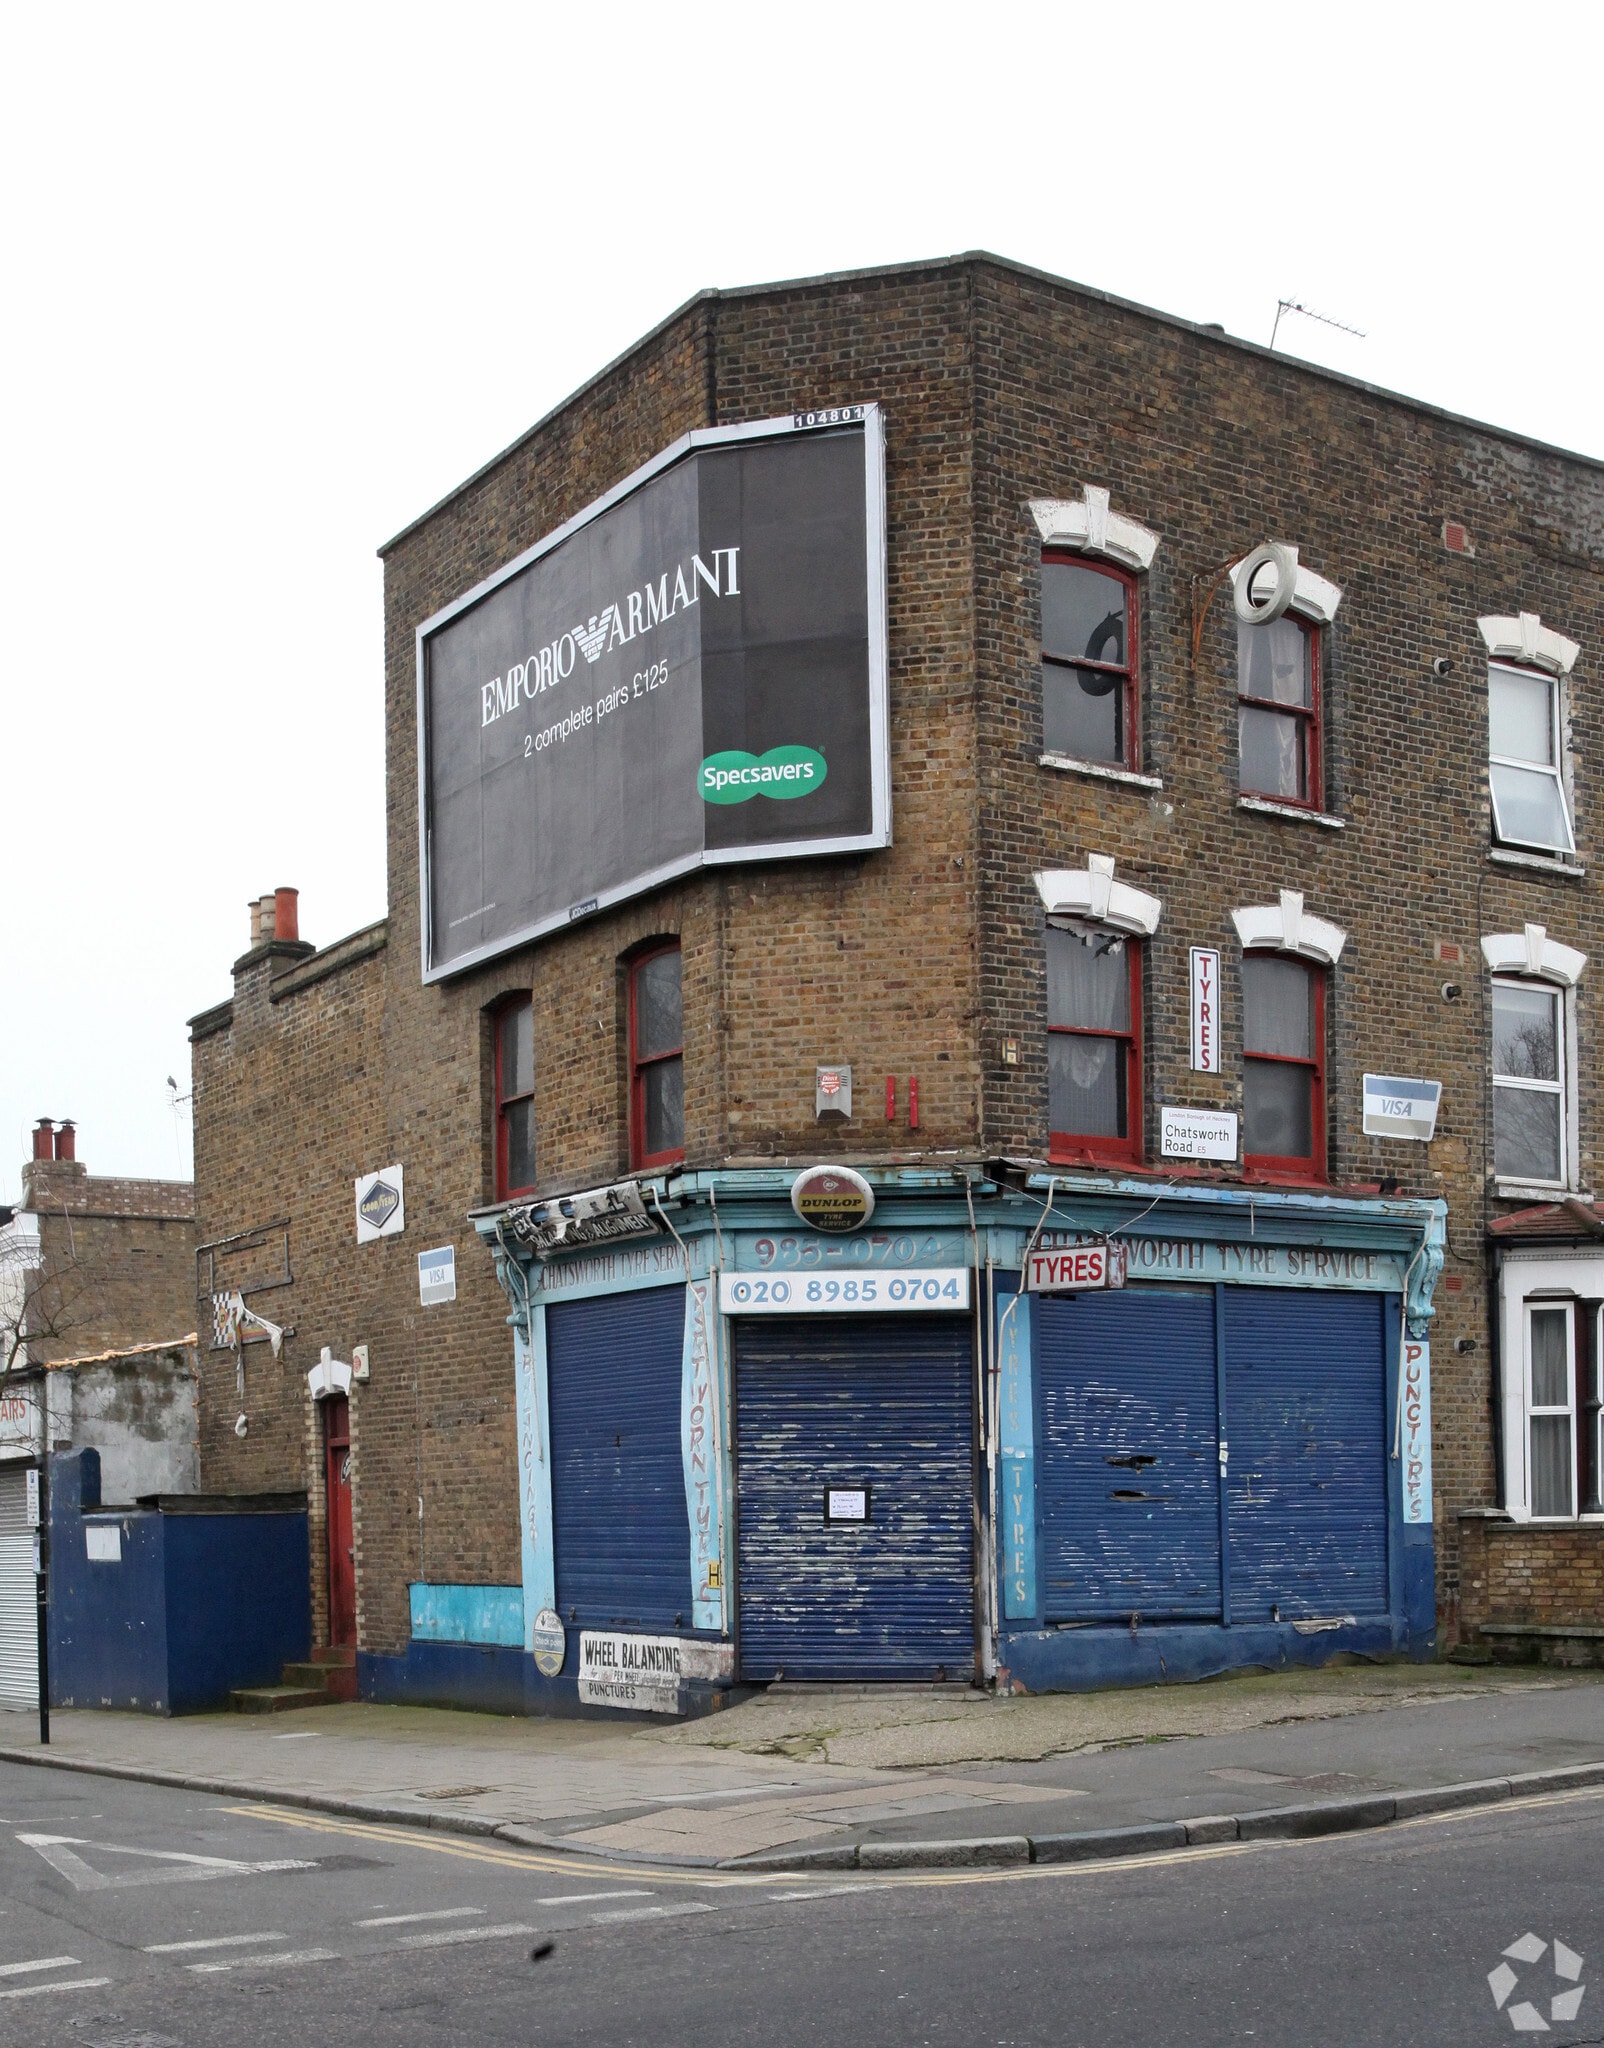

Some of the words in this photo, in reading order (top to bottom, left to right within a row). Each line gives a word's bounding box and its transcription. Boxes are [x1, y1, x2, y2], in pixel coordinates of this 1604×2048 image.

[795, 407, 862, 427] 104801
[481, 633, 576, 728] EMPORIO
[607, 547, 741, 653] ARMANI
[524, 734, 533, 758] 2
[535, 706, 593, 751] complete
[597, 685, 629, 724] pairs
[633, 658, 669, 699] £125
[704, 762, 814, 791] Specsavers
[1199, 956, 1212, 1070] TYRES
[1187, 1113, 1205, 1121] Borough
[1381, 1098, 1412, 1116] VISA
[1165, 1124, 1230, 1141] Chatsworth
[1165, 1138, 1193, 1153] Road
[1197, 1145, 1206, 1154] E5
[800, 1199, 861, 1207] DUNLOP
[429, 1268, 446, 1285] VISA
[541, 1256, 616, 1291] CHATSWORTH
[620, 1251, 649, 1277] TYRE
[653, 1239, 702, 1273] SERVICE
[1032, 1253, 1103, 1284] TYRES
[1216, 1244, 1278, 1274] TYRE
[1287, 1248, 1379, 1281] SERVICE
[731, 1279, 793, 1305] (020)
[805, 1279, 878, 1303] 8985
[888, 1277, 960, 1301] 0704
[1007, 1300, 1020, 1432] TYRES
[1405, 1344, 1424, 1522] PUNCTURES
[1012, 1465, 1026, 1602] TYRES
[584, 1639, 619, 1668] WHEEL
[621, 1642, 680, 1673] BALANCING
[588, 1682, 636, 1700] PUNCTURES
